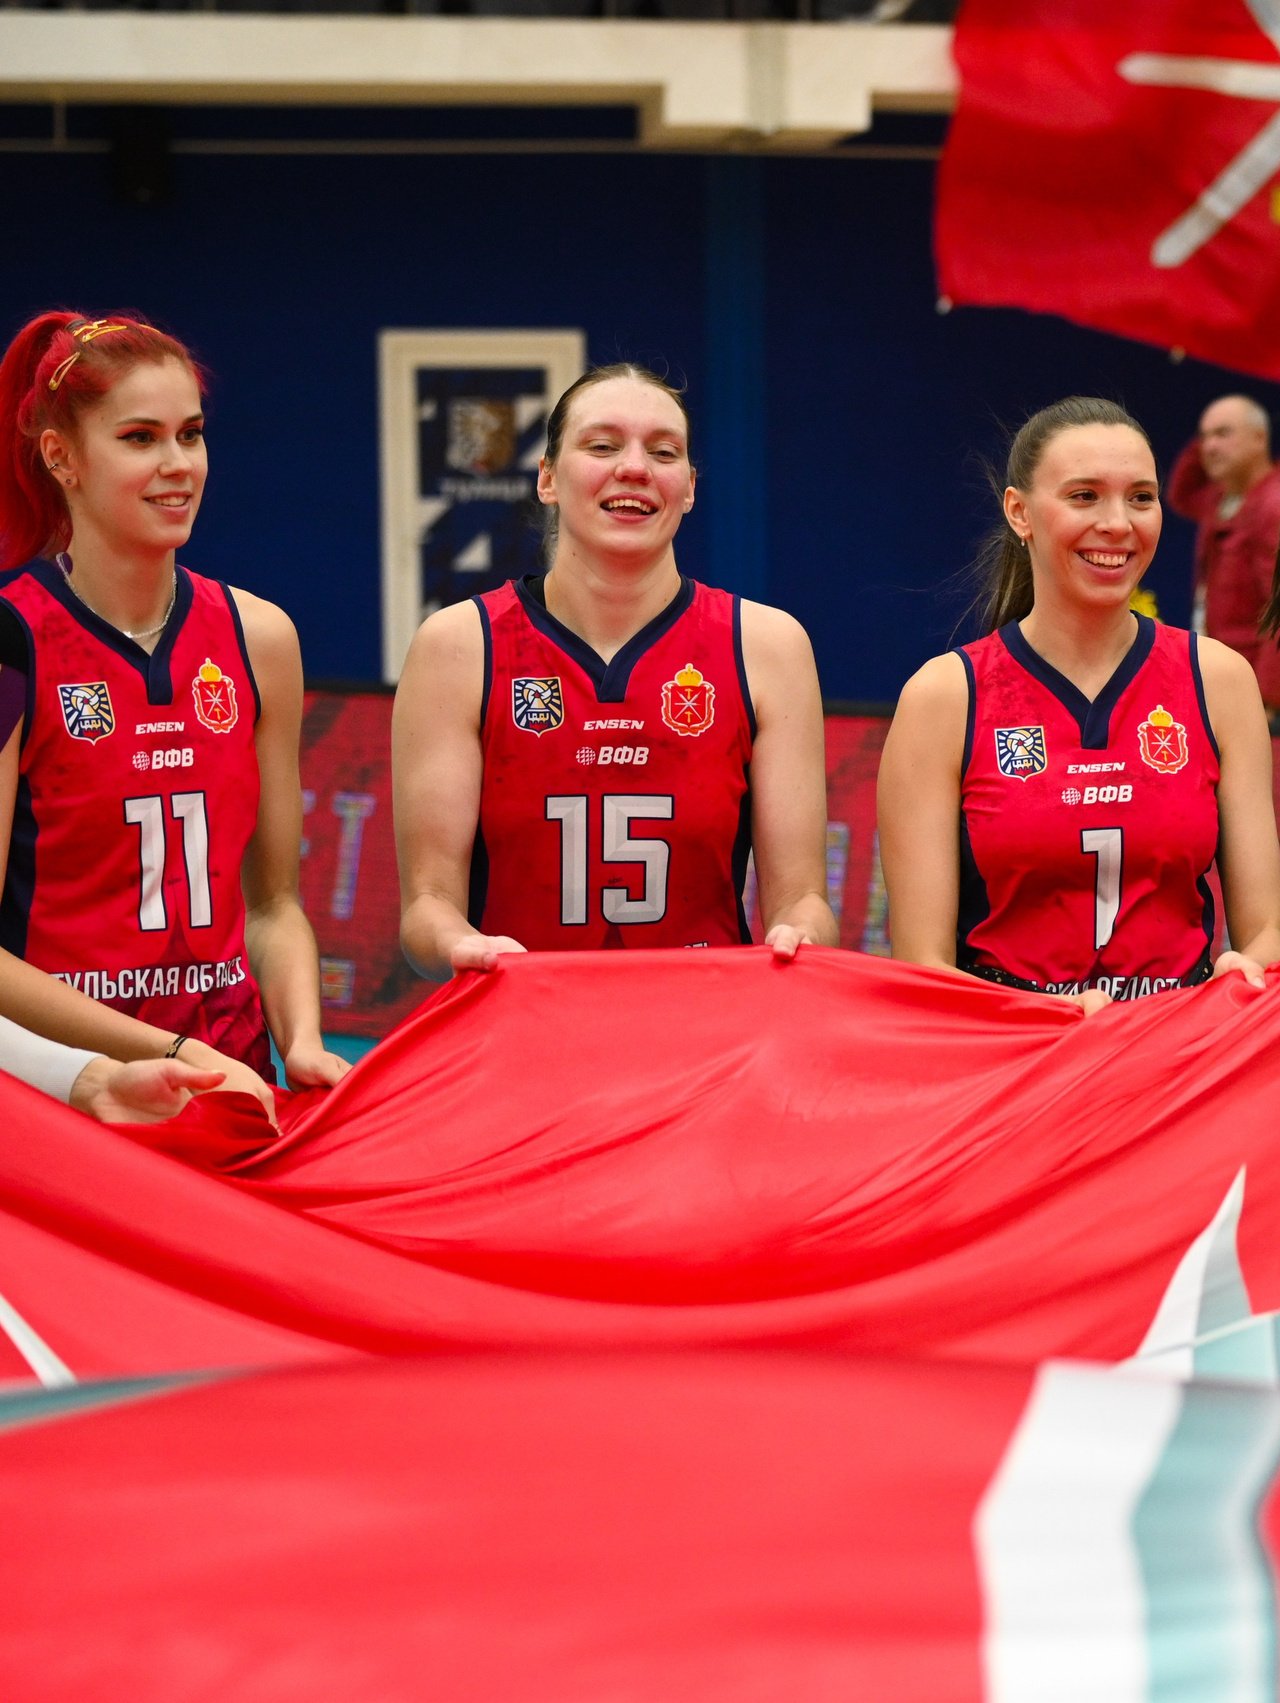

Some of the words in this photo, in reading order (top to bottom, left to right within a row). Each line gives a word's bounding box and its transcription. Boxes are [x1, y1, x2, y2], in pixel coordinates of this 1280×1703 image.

[135, 721, 185, 735] ENSEN
[583, 719, 645, 731] ENSEN
[151, 747, 194, 770] ВФВ
[597, 745, 650, 765] ВФВ
[1066, 761, 1126, 774] ENSEN
[1082, 784, 1134, 805] ВФВ
[123, 791, 213, 932] 11
[545, 794, 674, 925] 15
[1080, 827, 1123, 951] 1
[1095, 975, 1183, 1002] ОБЛАСТ
